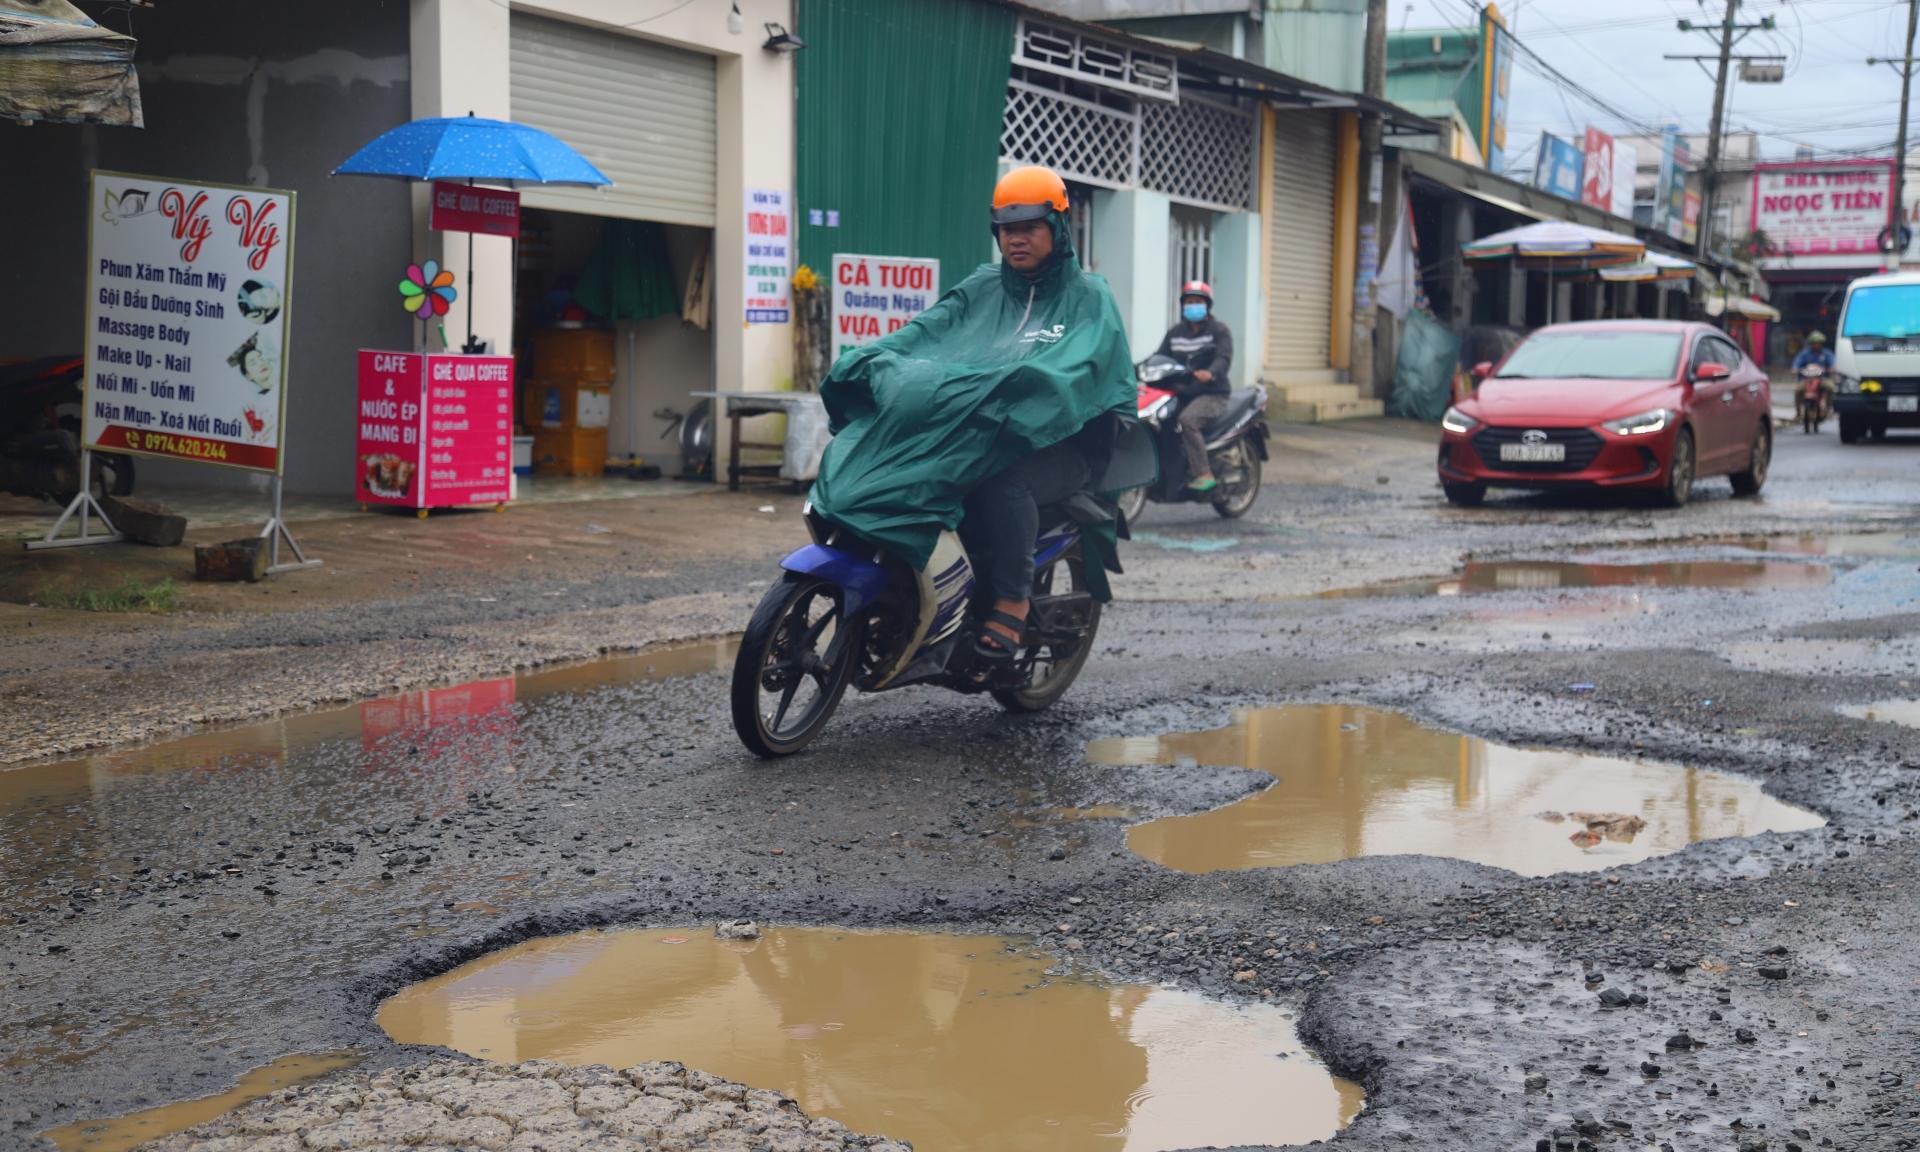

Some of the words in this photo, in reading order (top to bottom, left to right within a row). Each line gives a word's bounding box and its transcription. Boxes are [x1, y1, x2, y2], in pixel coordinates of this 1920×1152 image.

[483, 198, 517, 217] COFFEE
[1763, 194, 1823, 215] NGỌC
[158, 187, 213, 263] Vy
[225, 195, 281, 272] Vy
[100, 259, 132, 278] Phun
[136, 263, 164, 282] Xăm
[207, 271, 227, 292] Mỹ
[838, 258, 870, 286] CÁ
[878, 264, 932, 291] TƯƠI
[99, 288, 120, 309] Gội
[152, 294, 191, 317] Dưỡng
[195, 300, 224, 319] Sinh
[98, 316, 155, 340] Massage
[159, 324, 190, 346] Body
[838, 314, 881, 341] VỰA
[97, 345, 132, 365] Make
[136, 350, 152, 369] Up
[165, 354, 191, 373] Nail
[374, 354, 407, 373] CAFE
[433, 361, 453, 381] GHÉ
[455, 364, 476, 381] QUA
[477, 364, 508, 381] COFFEE
[96, 372, 118, 392] Nối
[121, 377, 138, 394] Mi
[150, 380, 174, 399] Uốn
[178, 384, 195, 402] Mi
[385, 378, 395, 396] &
[95, 402, 120, 423] Nặn
[188, 413, 210, 433] Nốt
[361, 398, 397, 420] NƯỚC
[401, 401, 418, 421] ÉP
[145, 433, 227, 459] 0974.620.244
[361, 423, 399, 443] MANG
[403, 426, 417, 444] ĐI
